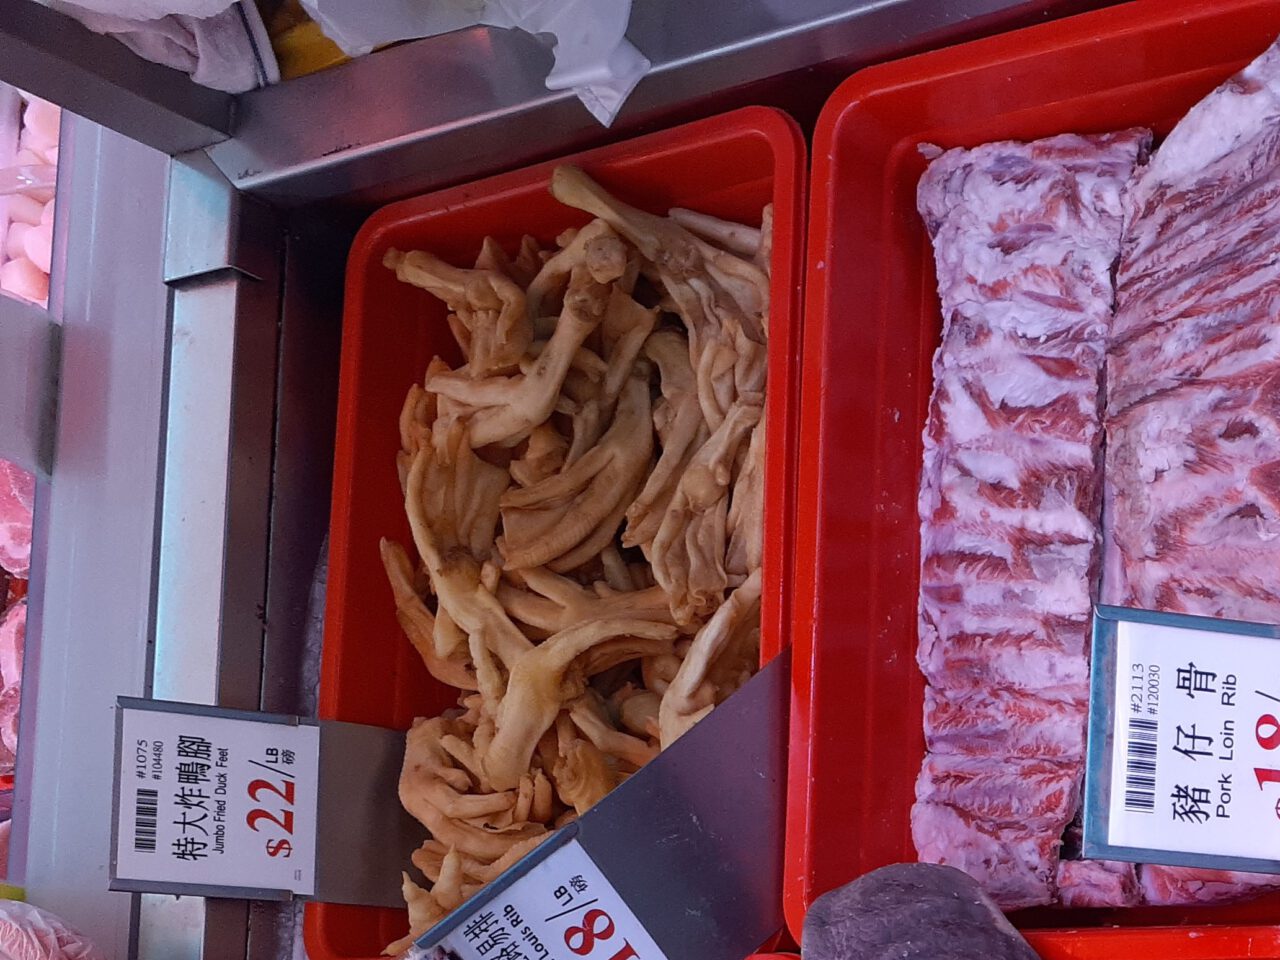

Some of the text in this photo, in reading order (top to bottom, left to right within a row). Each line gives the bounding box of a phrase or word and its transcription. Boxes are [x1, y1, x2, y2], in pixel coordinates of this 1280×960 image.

[1131, 663, 1144, 713] #2113
[1147, 664, 1161, 715] #120030
[136, 739, 148, 779] #1075
[152, 740, 164, 780] #104480
[281, 749, 296, 765] 磅
[1217, 674, 1237, 818] Pork Loin Rib
[171, 735, 213, 861] 特大炸鴨腳
[212, 748, 229, 854] Jumbo Fried Duck Feet
[569, 874, 589, 894] 磅
[503, 903, 525, 928] Rib
[520, 926, 549, 960] Louis
